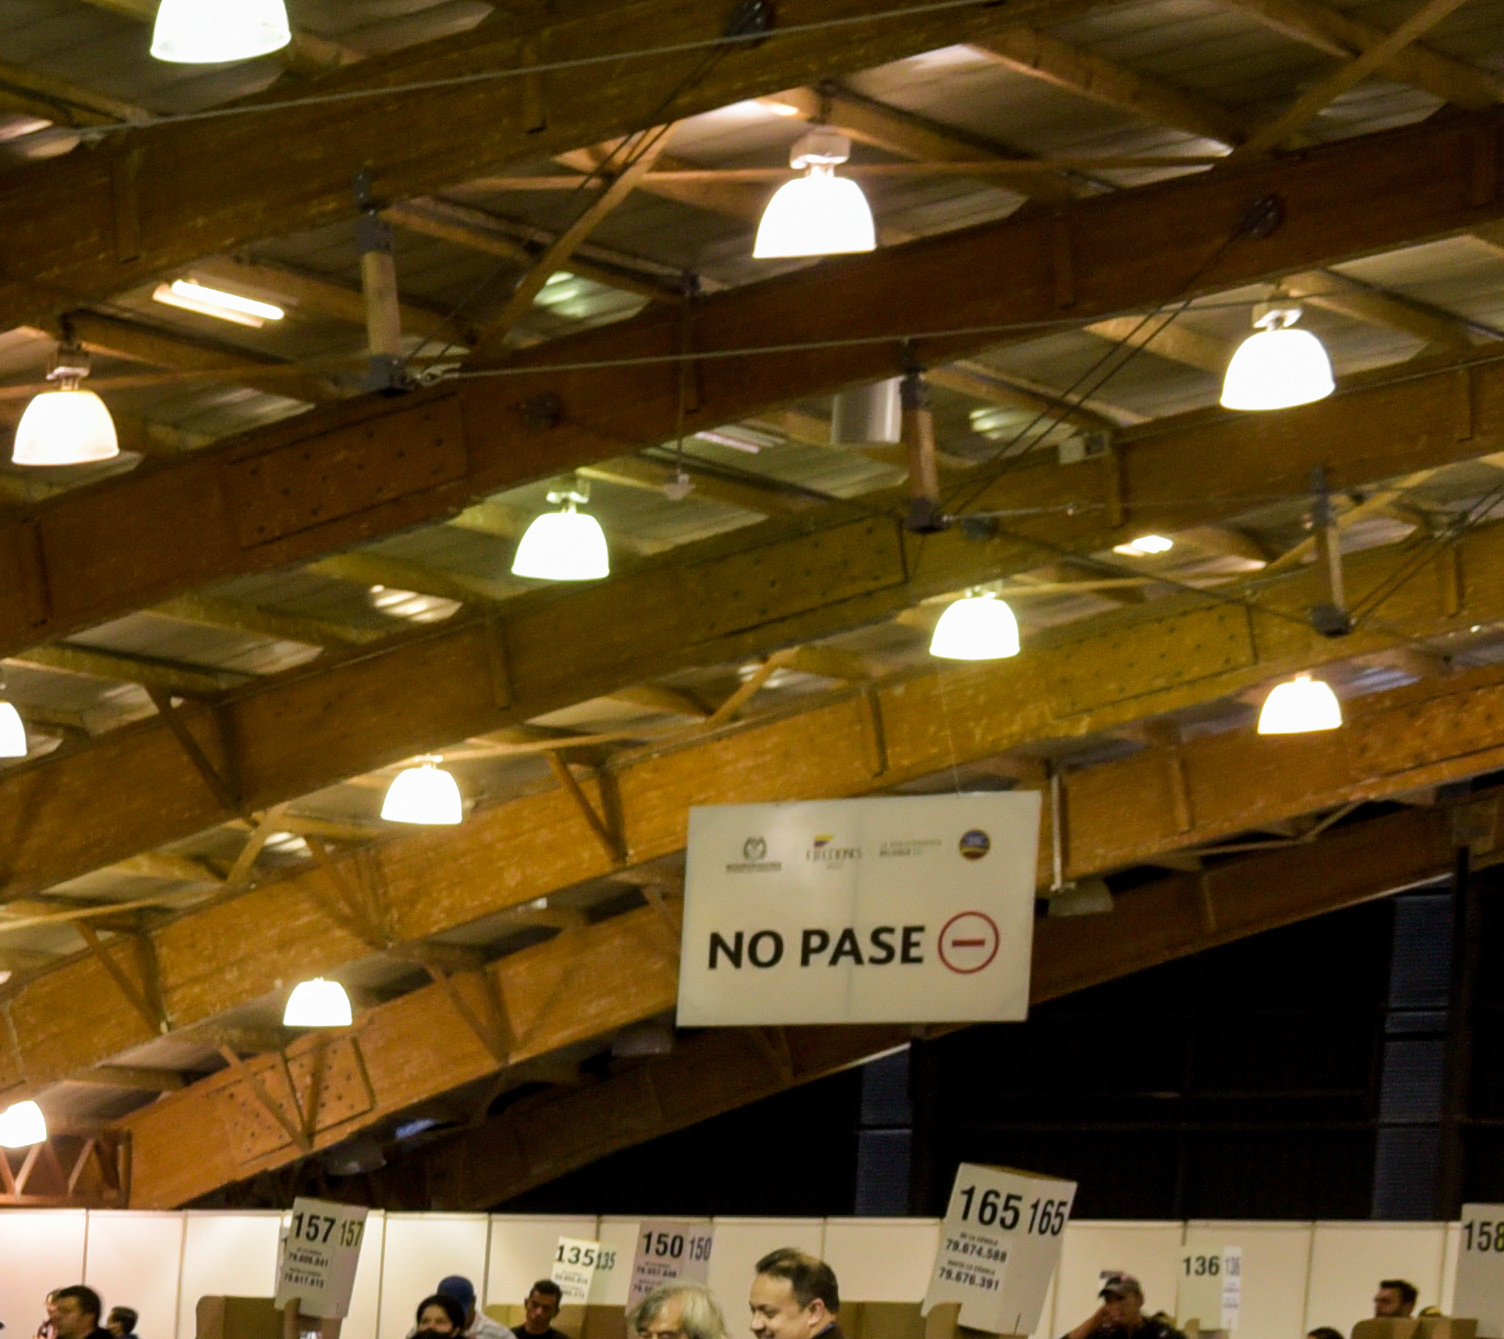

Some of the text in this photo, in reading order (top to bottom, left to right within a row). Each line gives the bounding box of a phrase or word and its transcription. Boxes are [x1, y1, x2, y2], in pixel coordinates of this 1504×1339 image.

[708, 924, 927, 970] NO PASE
[960, 1185, 1023, 1231] 165
[1028, 1198, 1068, 1237] 165
[295, 1212, 337, 1244] 157
[338, 1220, 365, 1248] 157
[1464, 1220, 1504, 1253] 158
[556, 1244, 596, 1267] 135
[643, 1231, 685, 1259] 150
[689, 1237, 713, 1261] 150
[595, 1250, 617, 1271] 135
[1183, 1255, 1221, 1277] 136
